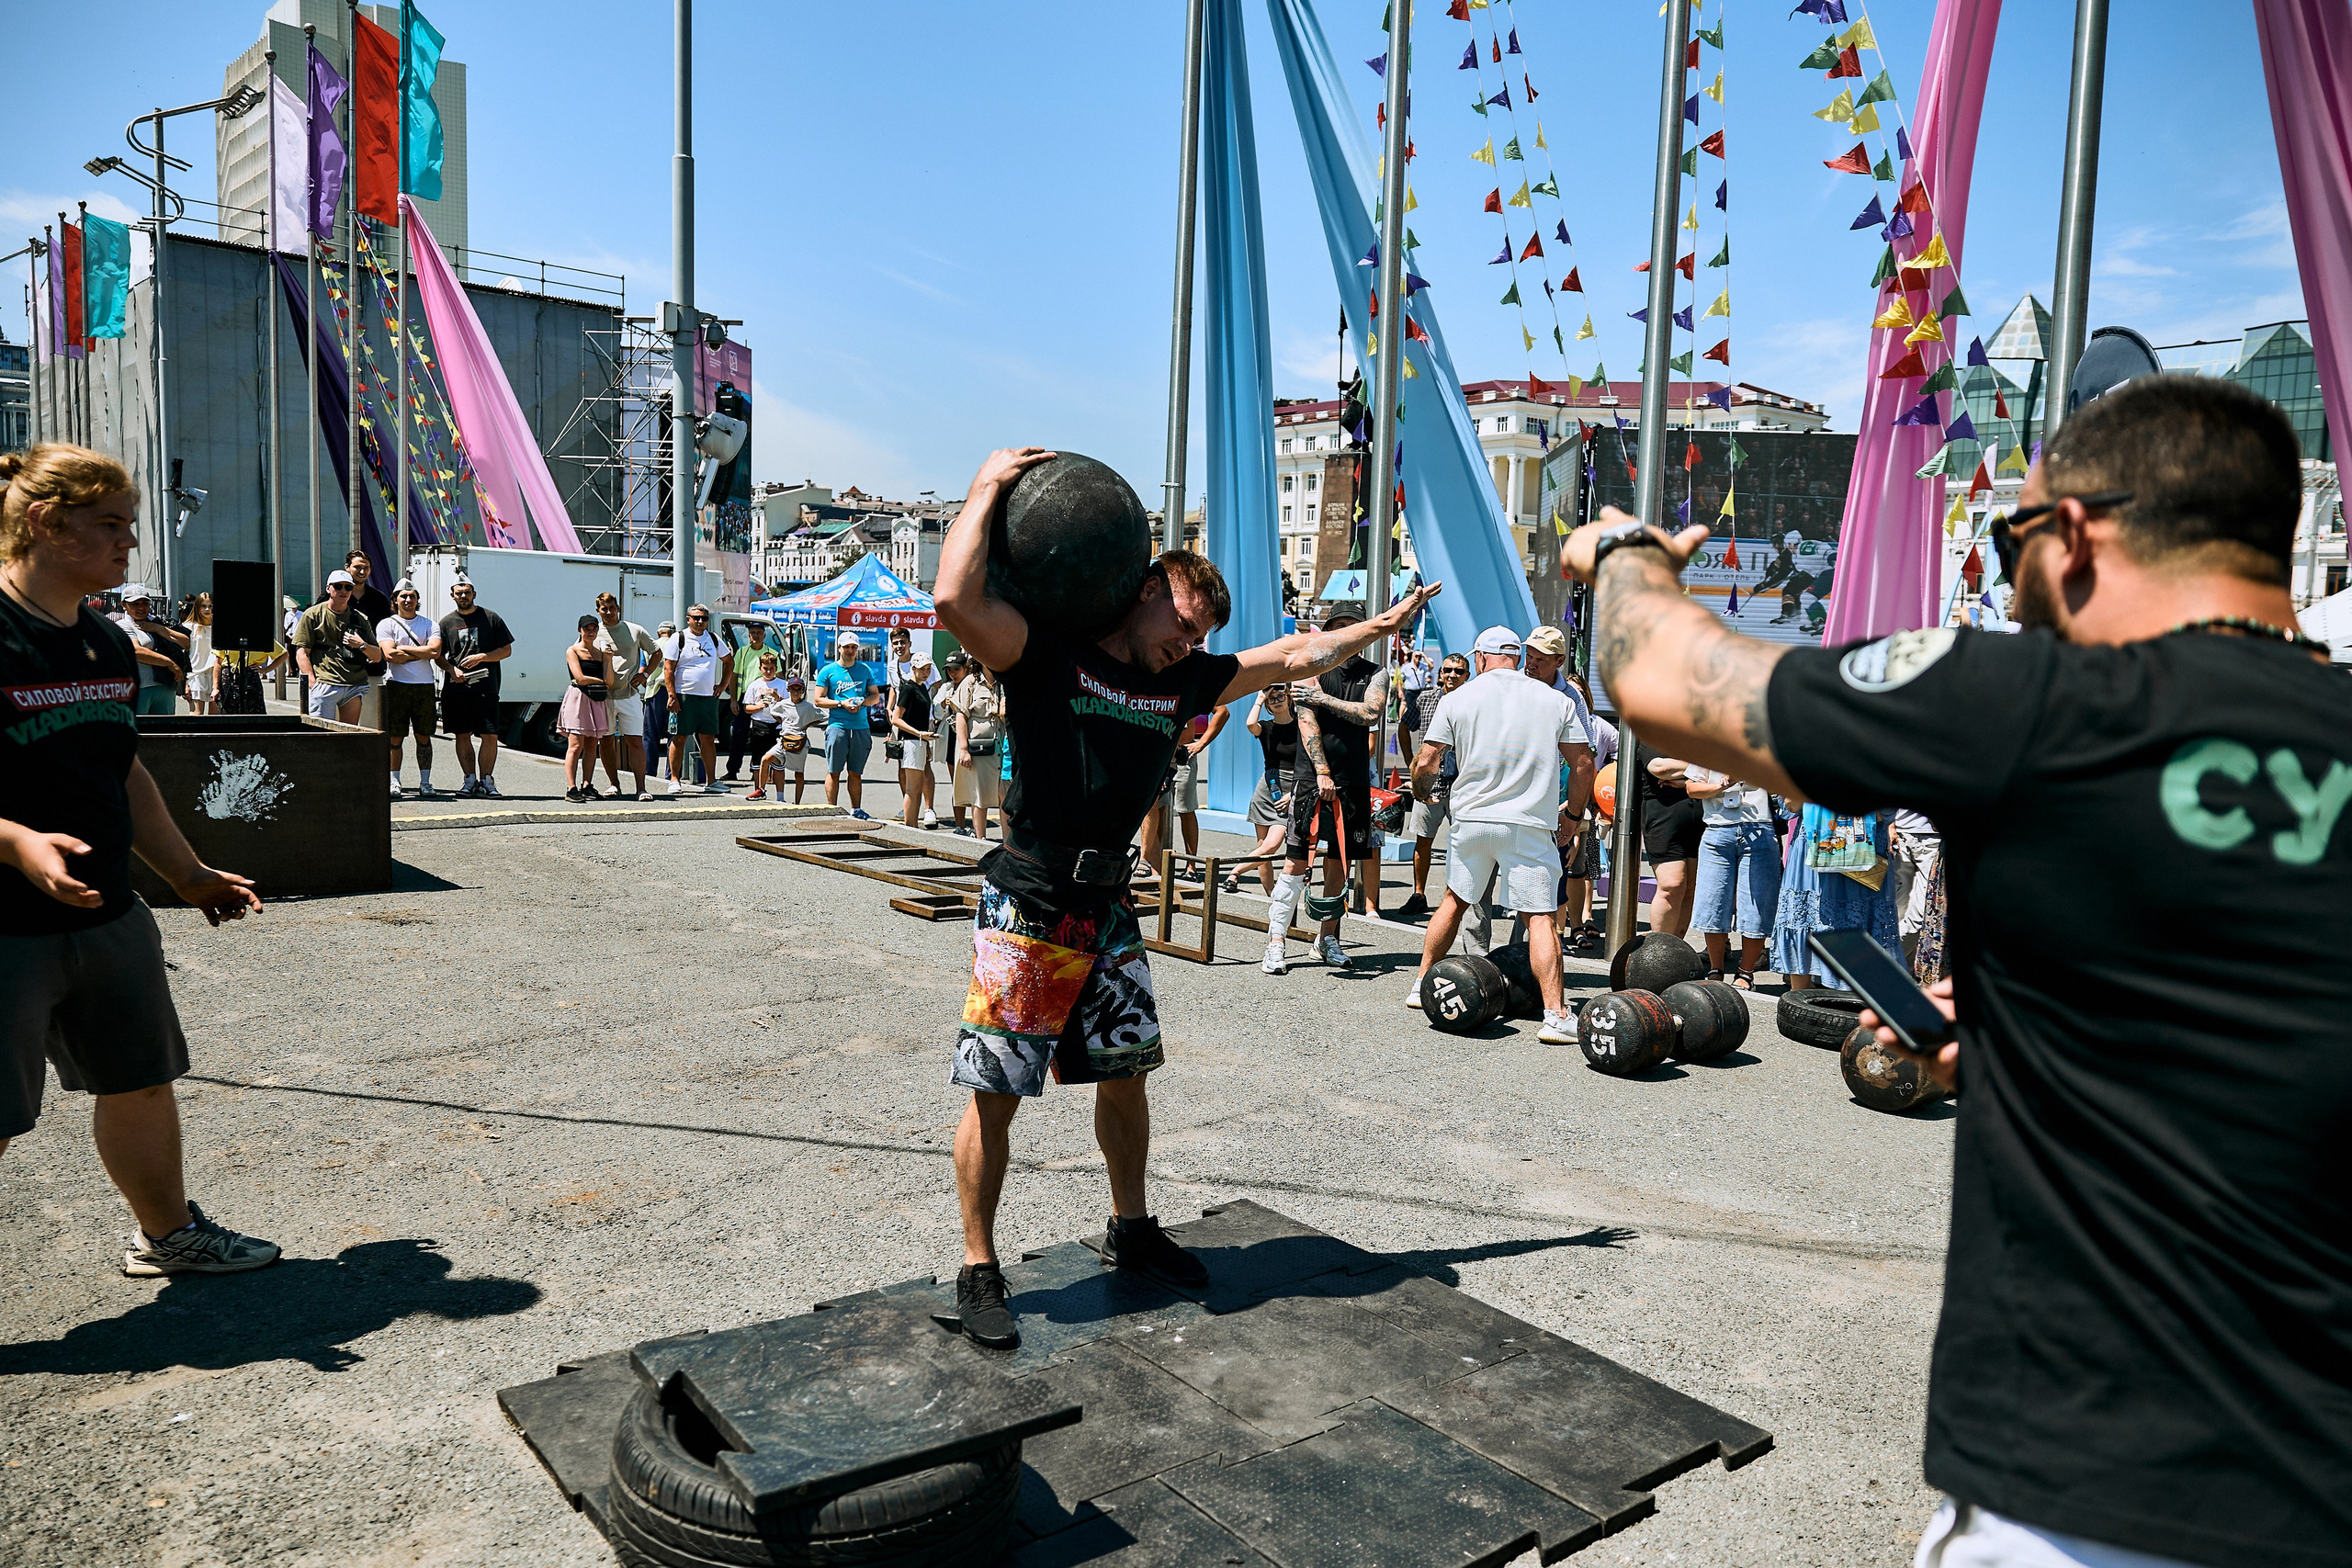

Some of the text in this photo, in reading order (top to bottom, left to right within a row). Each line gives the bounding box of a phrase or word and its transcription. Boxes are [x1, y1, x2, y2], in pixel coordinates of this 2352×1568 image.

[865, 615, 887, 623] slavda
[903, 615, 924, 624] slavda
[13, 682, 83, 707] СИЛОВОЙ
[1080, 672, 1127, 705] СИЛОВОЙ
[1432, 976, 1468, 1021] 45
[1589, 1006, 1617, 1056] 35
